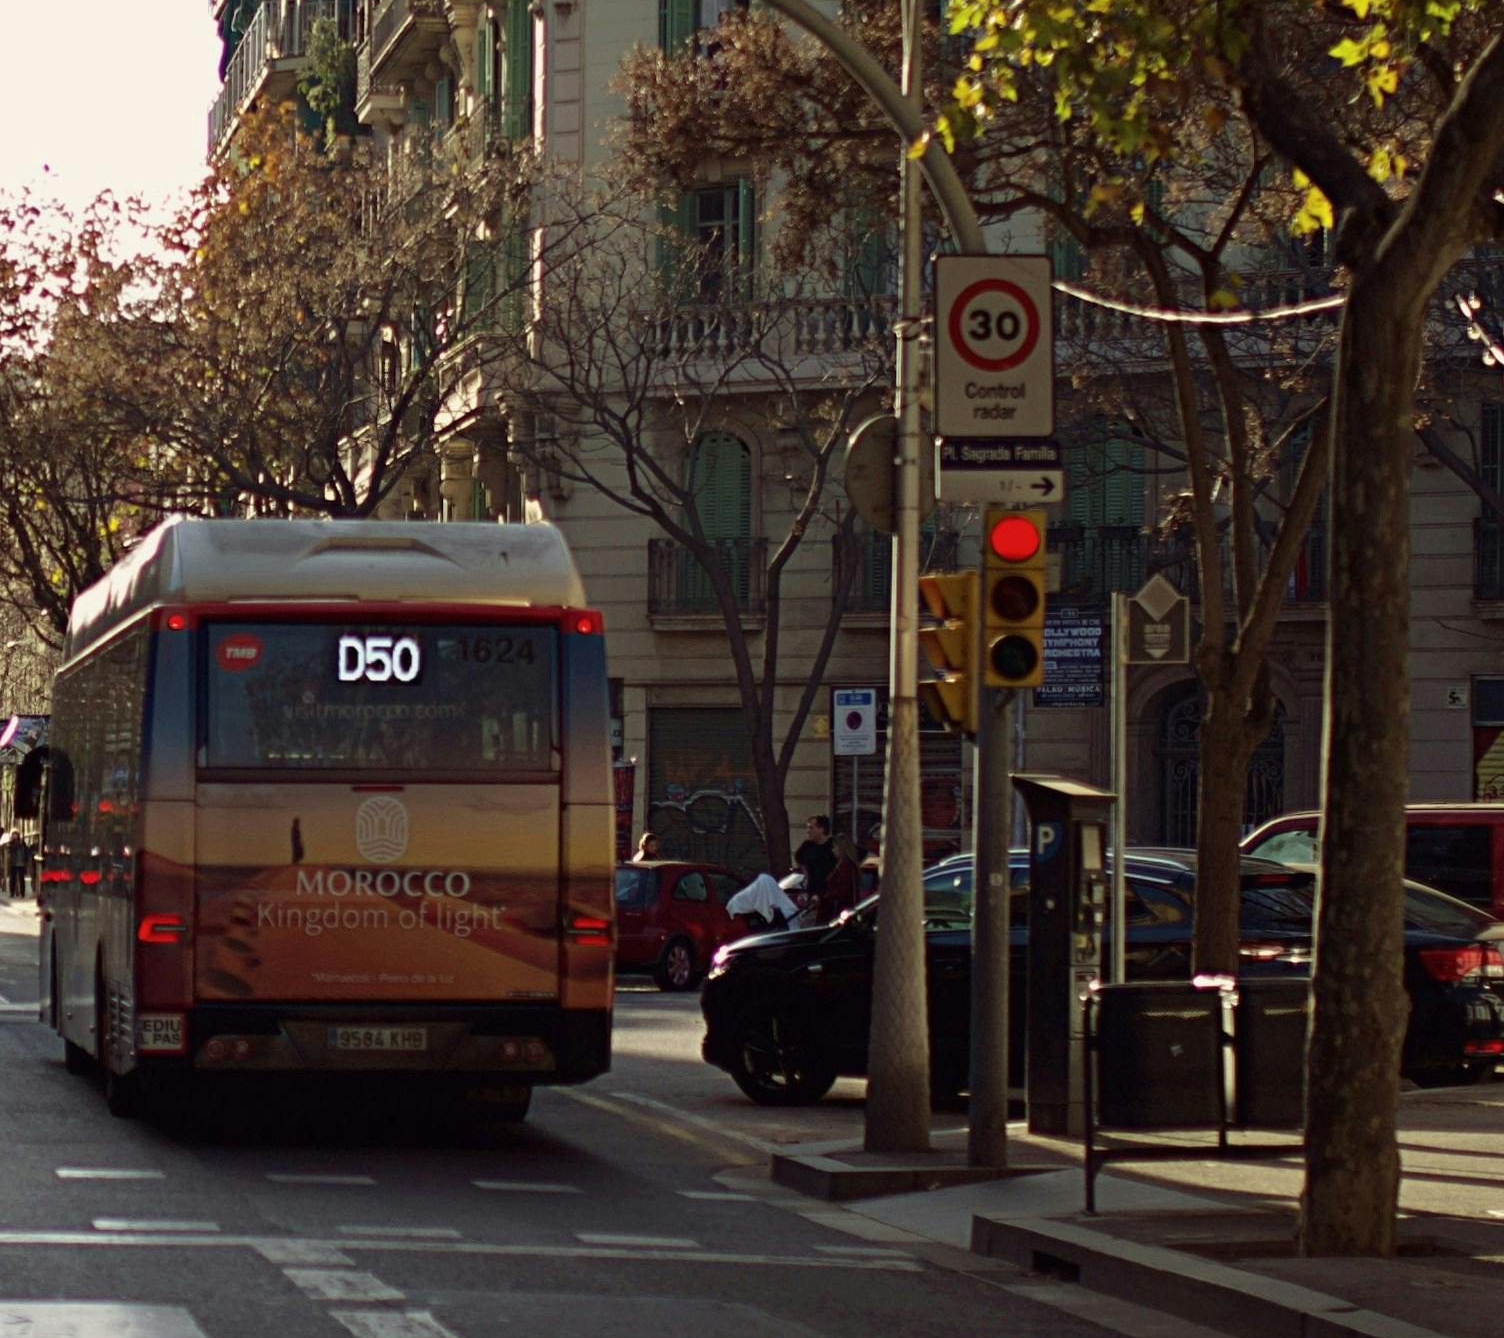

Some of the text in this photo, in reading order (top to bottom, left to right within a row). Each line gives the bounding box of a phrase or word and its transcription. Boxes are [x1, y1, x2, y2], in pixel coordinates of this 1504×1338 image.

[968, 310, 1020, 340] 30
[965, 382, 1026, 400] Control
[973, 404, 1017, 420] radar
[1044, 627, 1102, 637] OLLYWOOD
[458, 637, 535, 664] 1624
[1044, 638, 1099, 648] YMPHONY
[225, 646, 258, 660] TMB
[337, 635, 421, 682] D50
[1037, 825, 1056, 855] P
[295, 869, 472, 898] MOROCCO
[256, 901, 390, 937] Kingdom
[398, 901, 430, 930] of
[141, 1019, 182, 1032] EDIU
[152, 1033, 182, 1046] PAS
